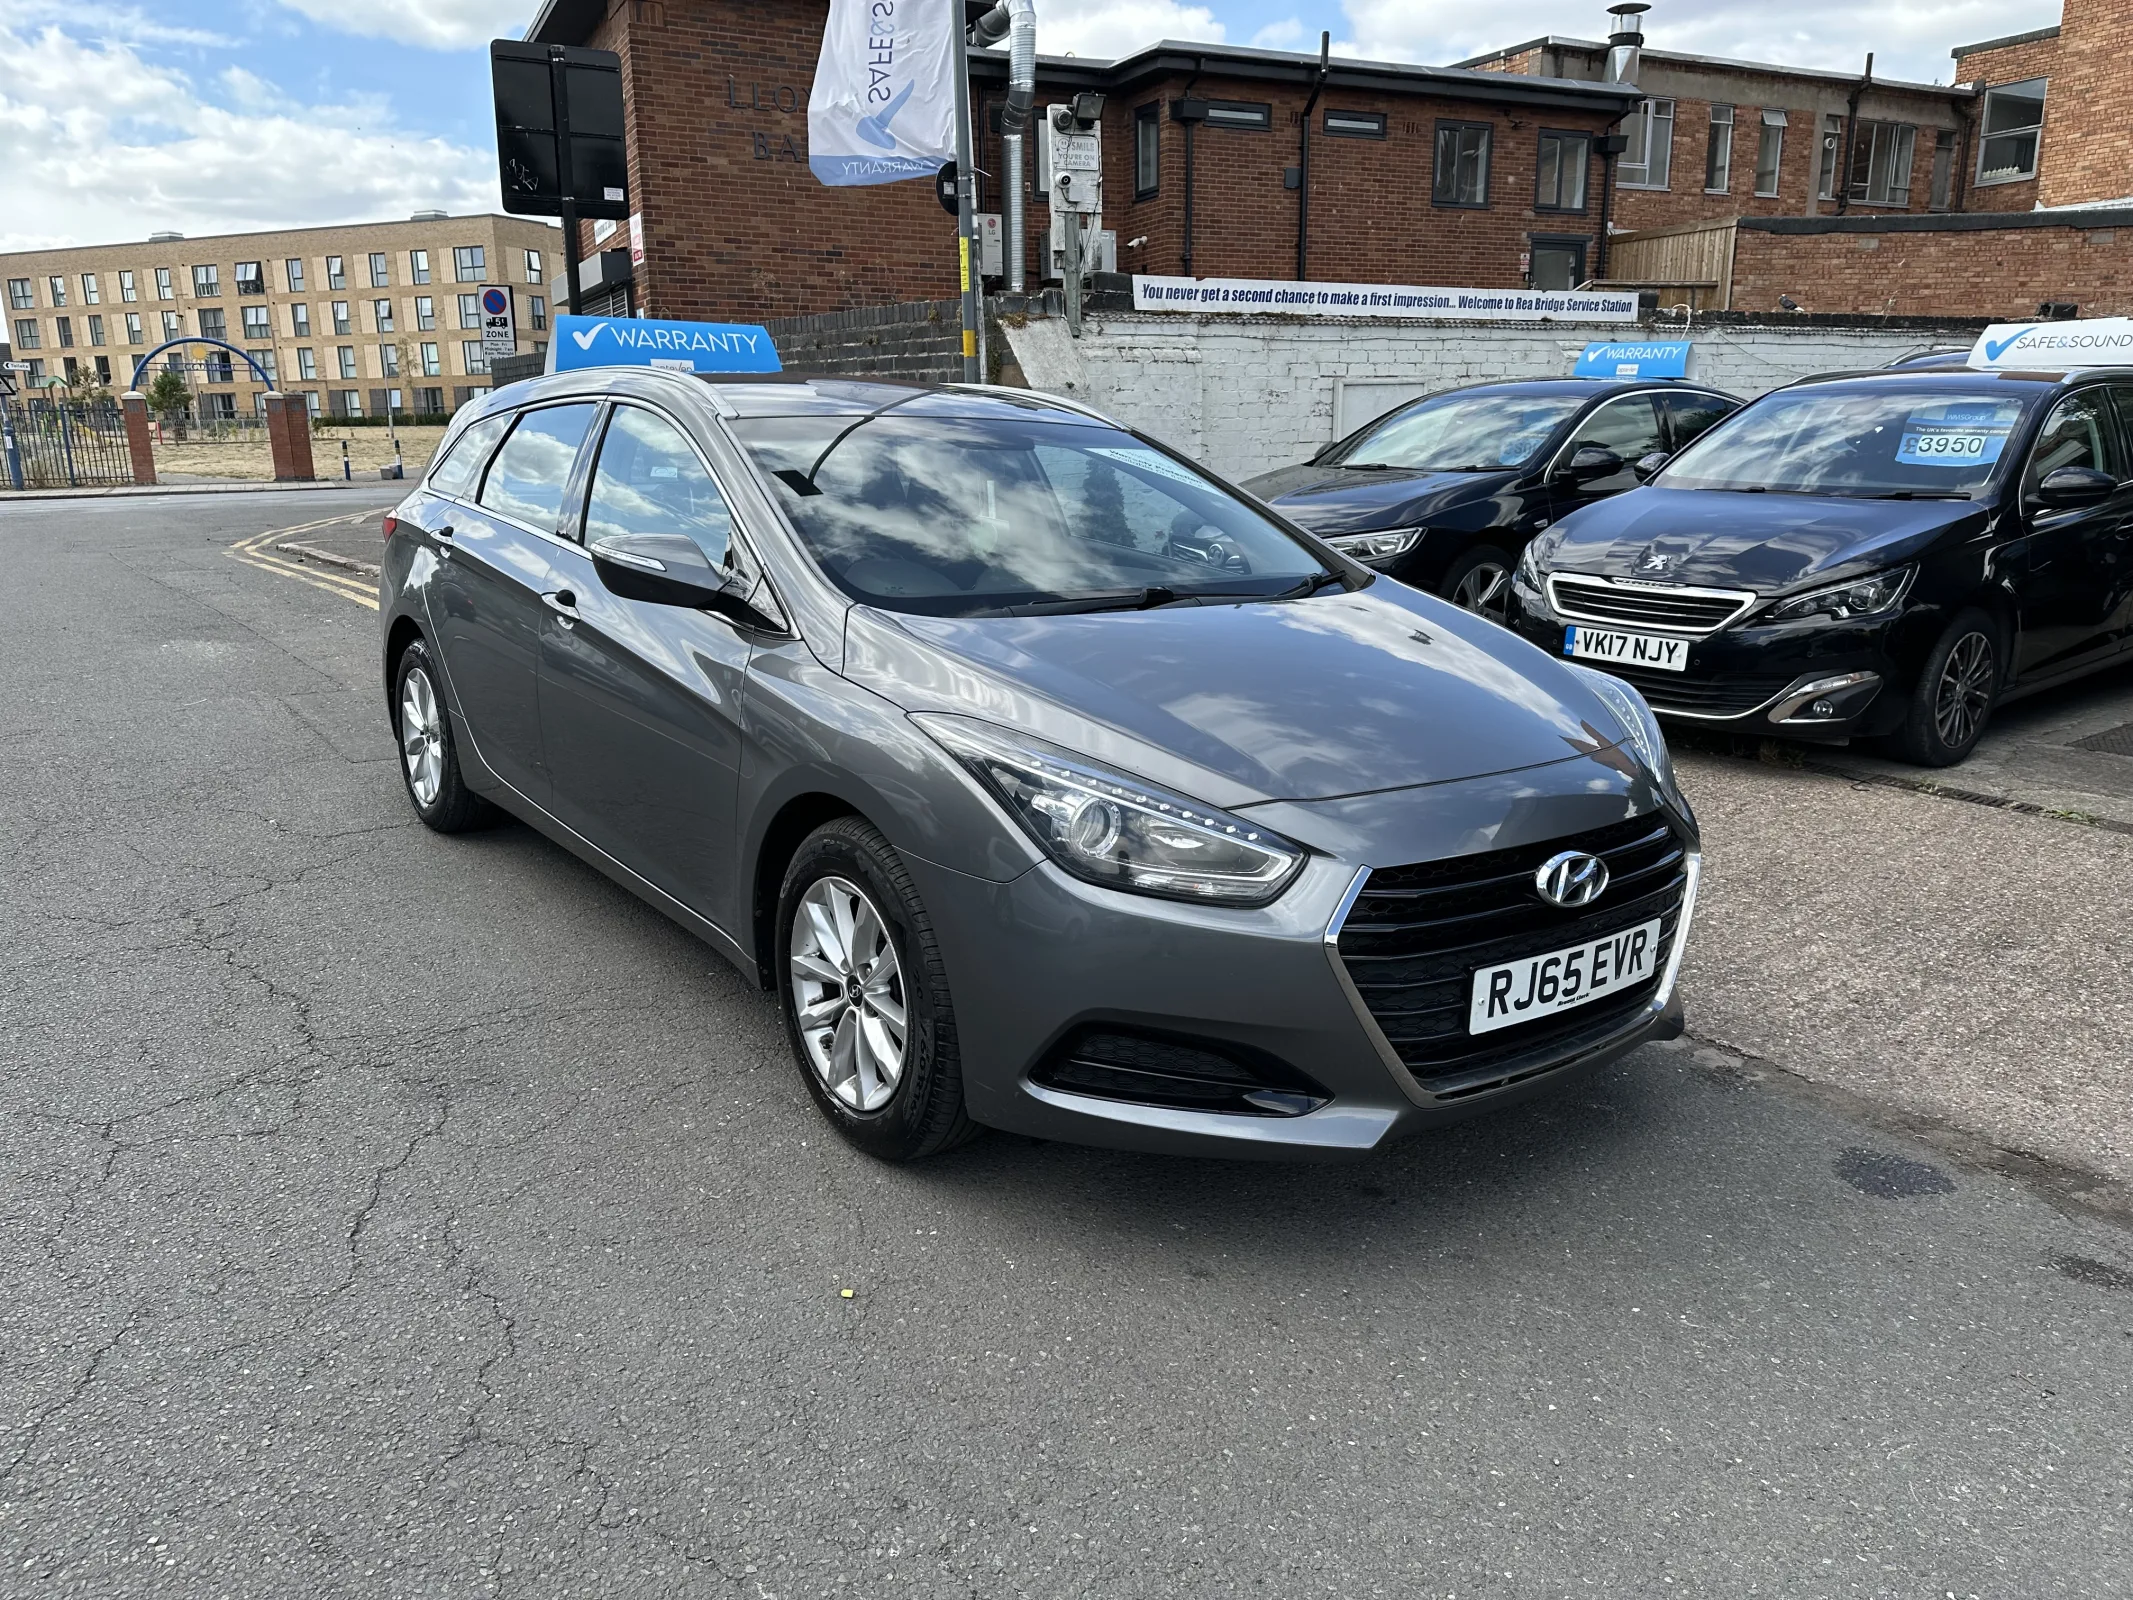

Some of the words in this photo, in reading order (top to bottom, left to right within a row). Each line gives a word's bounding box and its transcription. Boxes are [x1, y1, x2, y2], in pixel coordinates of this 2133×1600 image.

[752, 131, 804, 163] BA
[1071, 141, 1095, 152] SMILE
[1084, 154, 1096, 162] ON
[1142, 284, 1163, 299] You
[1165, 287, 1199, 301] never
[1200, 288, 1221, 302] get
[1222, 289, 1230, 301] a
[1231, 289, 1273, 303] second
[1274, 289, 1315, 304] chance
[1316, 291, 1329, 304] to
[1330, 291, 1359, 306] make
[1361, 294, 1368, 306] a
[1369, 292, 1392, 307] first
[1393, 293, 1456, 309] impression...
[1458, 295, 1503, 310] Welcome
[1504, 296, 1514, 310] to
[1515, 297, 1533, 311] Rea
[1534, 297, 1565, 313] Bridge
[1566, 298, 1600, 312] Service
[1600, 299, 1633, 313] Station
[485, 330, 509, 338] ZONE
[610, 326, 758, 354] WARRANTY
[2016, 334, 2133, 350] SAFE&SOUND
[1606, 347, 1682, 360] WARRANTY
[1583, 630, 1628, 657] VK17
[1633, 637, 1679, 664] NJY
[1487, 949, 1585, 1019] RJ65
[1590, 928, 1648, 990] EVR
